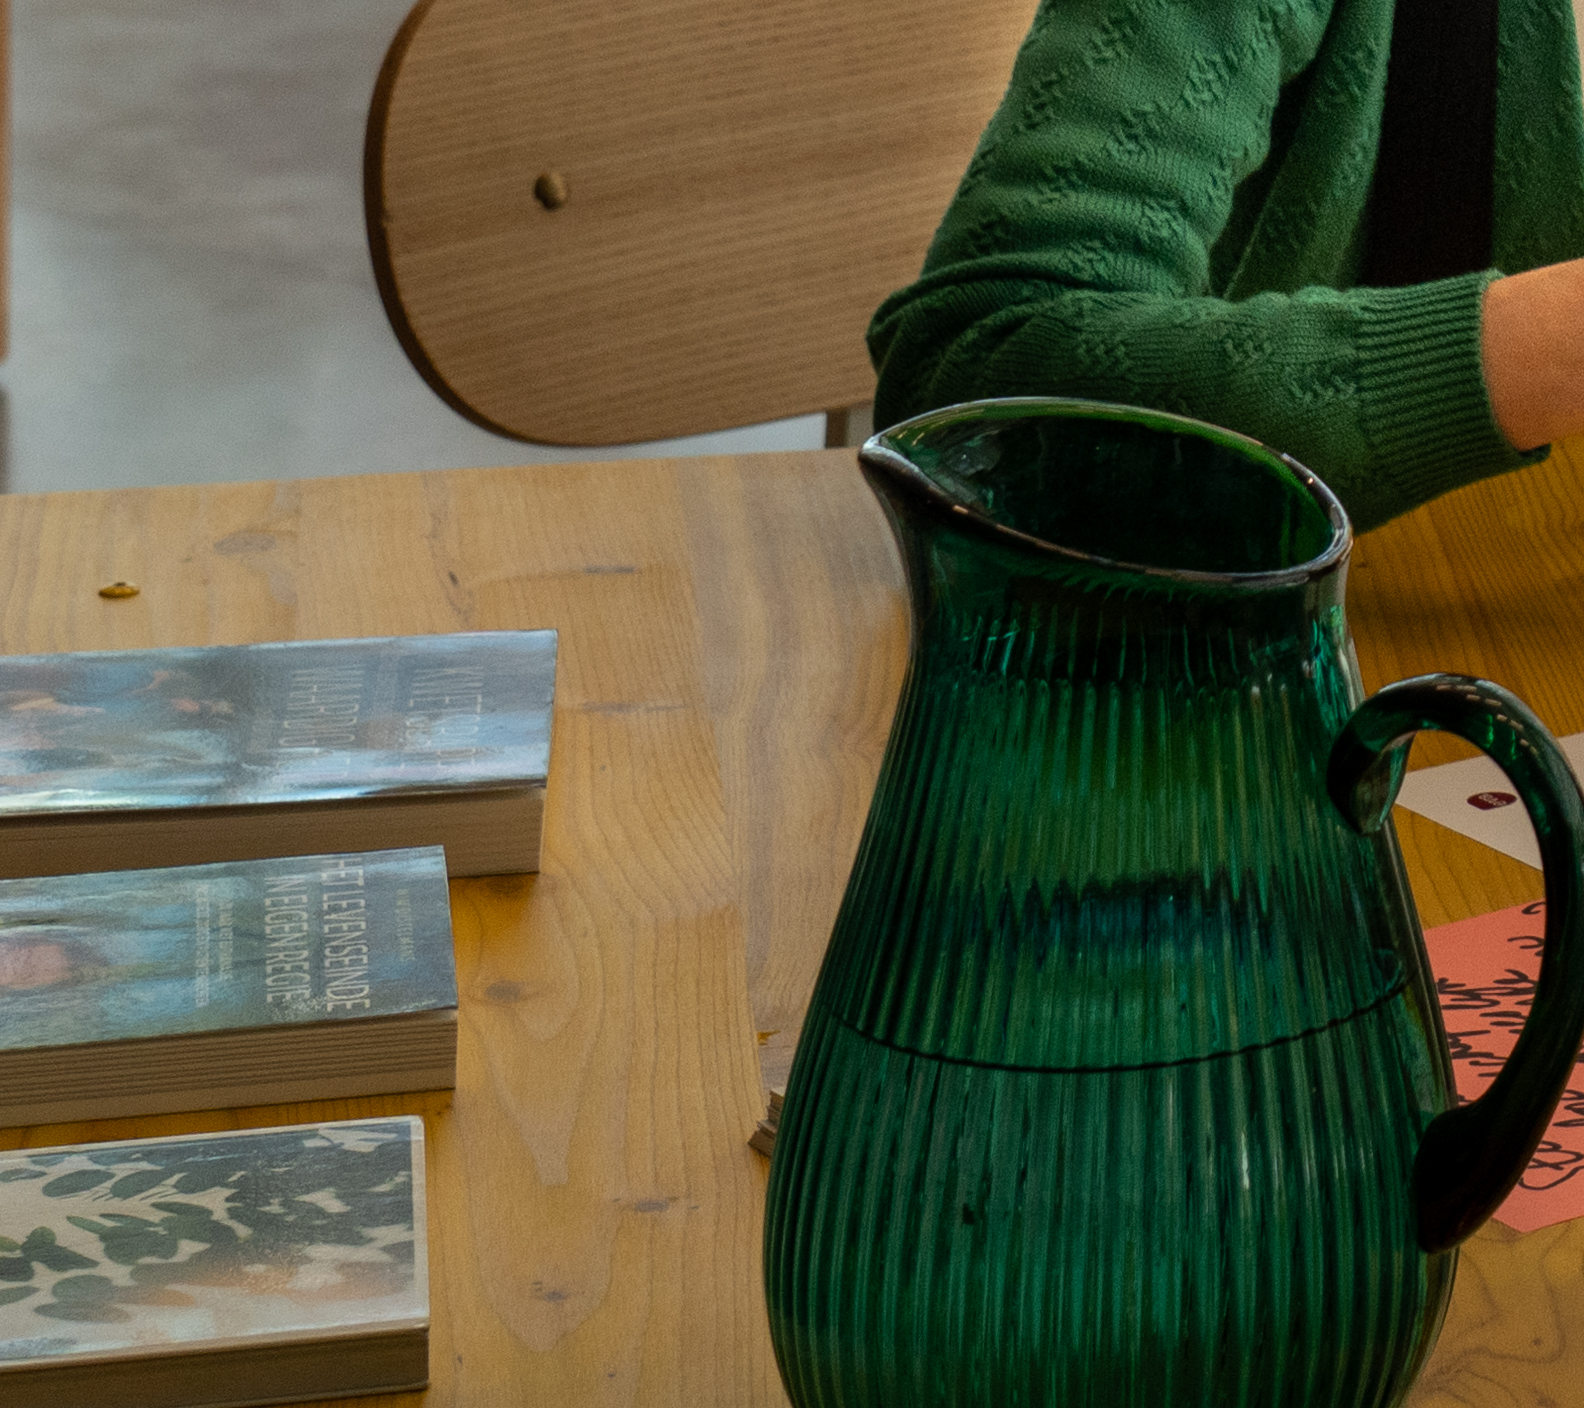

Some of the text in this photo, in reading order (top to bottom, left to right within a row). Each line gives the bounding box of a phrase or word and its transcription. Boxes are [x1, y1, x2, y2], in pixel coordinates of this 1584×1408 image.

[262, 872, 311, 1003] IN EIGEN REGIE
[318, 854, 372, 1012] HET LEVENSEINDE
